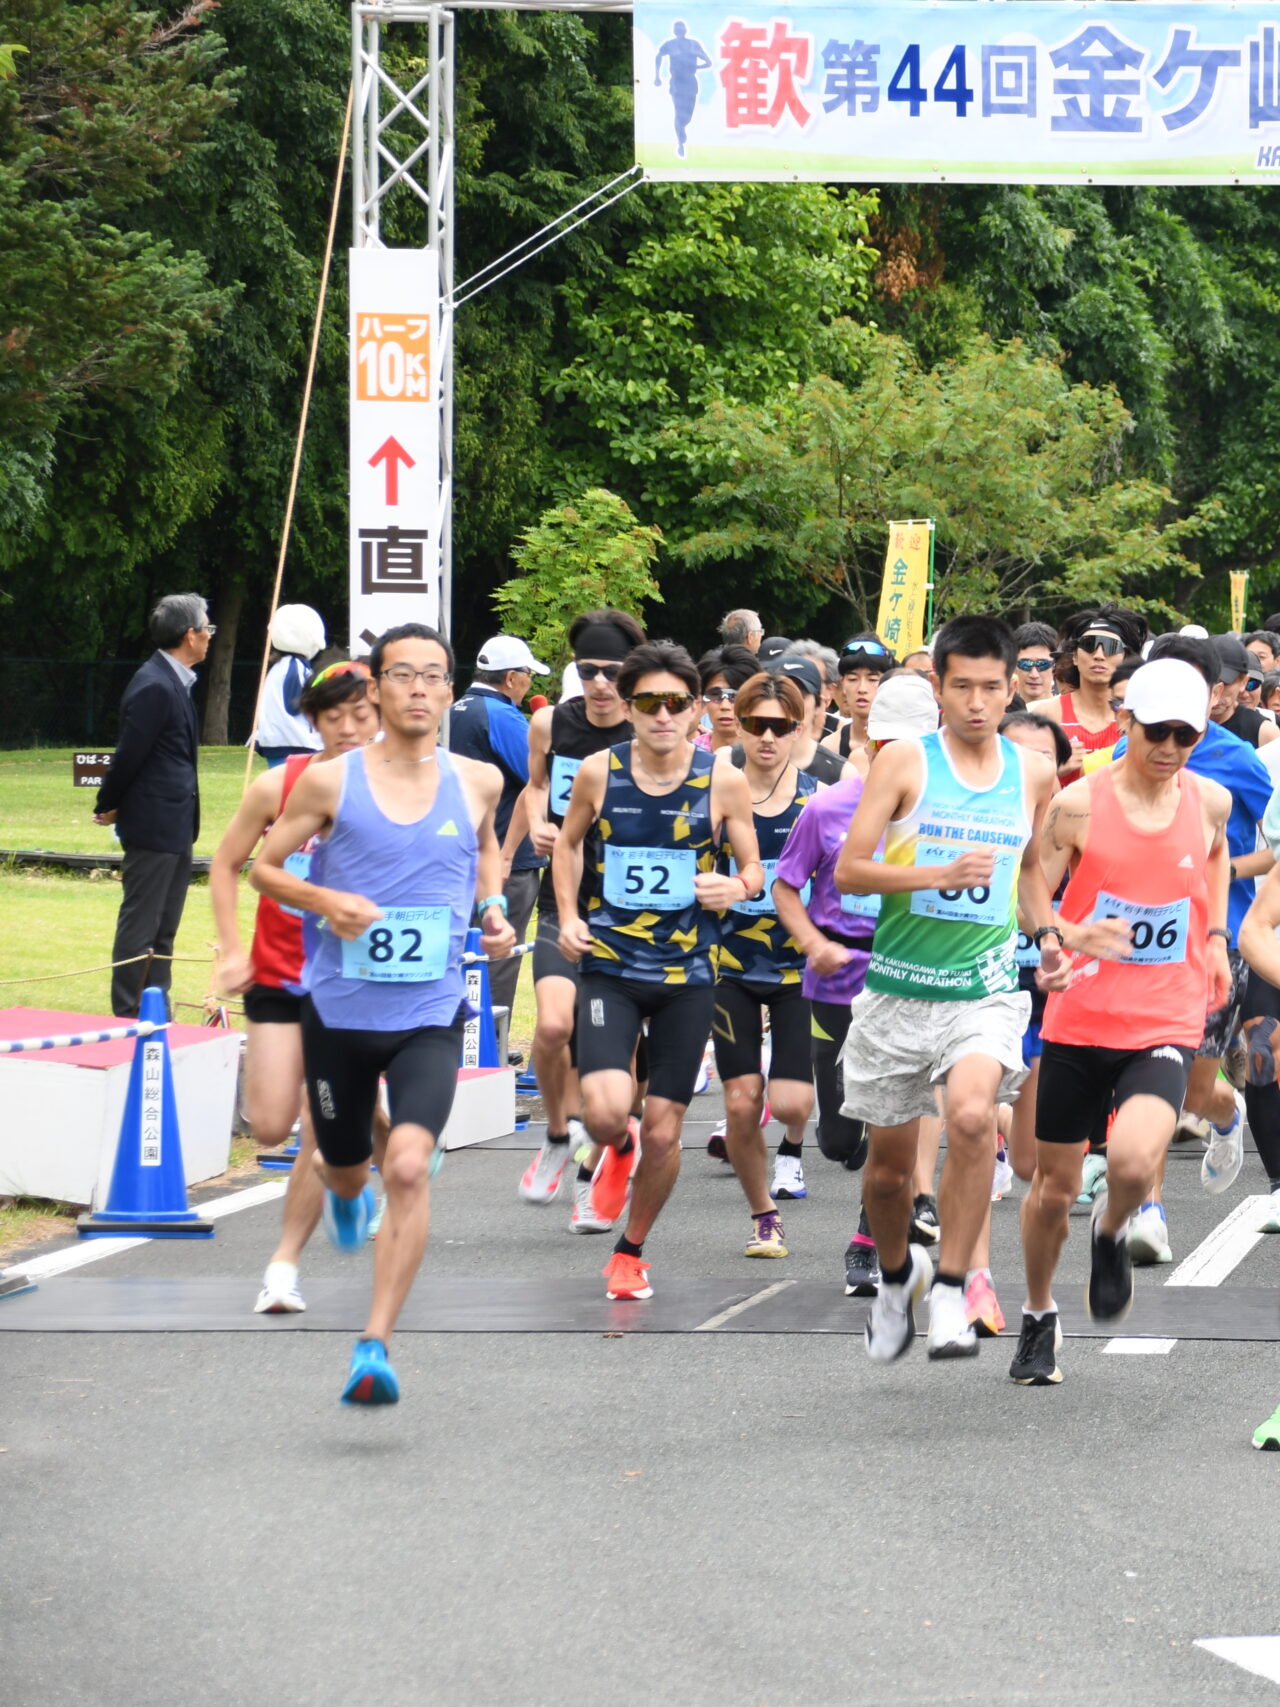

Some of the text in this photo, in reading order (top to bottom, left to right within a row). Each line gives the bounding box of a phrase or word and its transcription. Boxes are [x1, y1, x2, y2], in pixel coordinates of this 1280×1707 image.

[360, 317, 428, 340] ハーフ
[917, 822, 1025, 848] RUN THE CAUSEWAY
[624, 865, 670, 895] 52
[384, 909, 441, 921] 手朝日テレビ
[368, 927, 423, 963] 82
[868, 959, 973, 988] MONTHLY MARATHON
[464, 974, 480, 1067] 森山合公園
[143, 1047, 161, 1161] 森山総合公園
